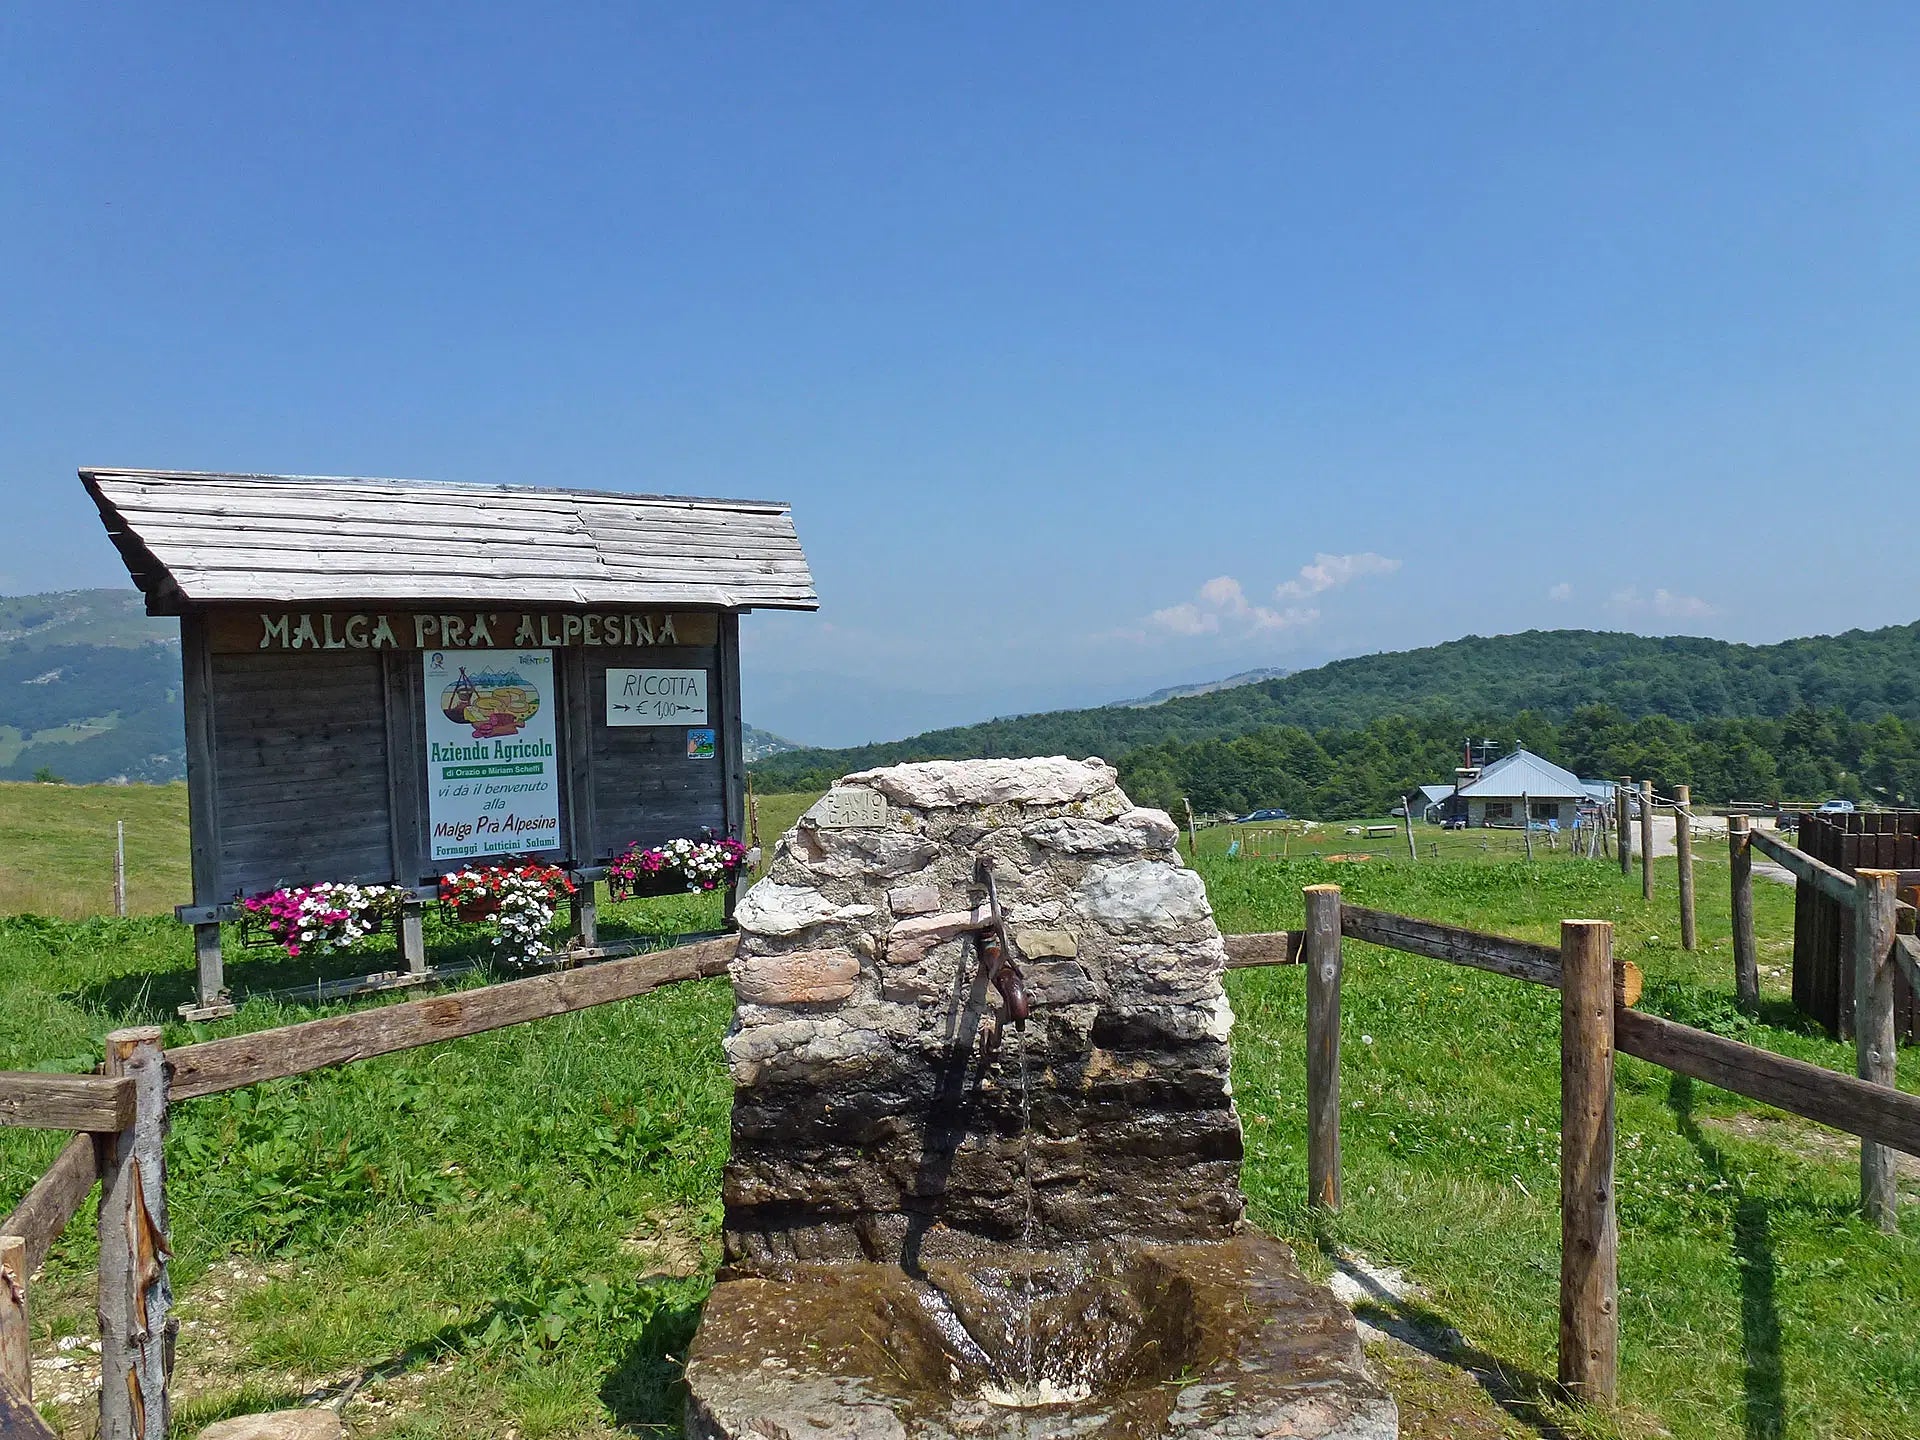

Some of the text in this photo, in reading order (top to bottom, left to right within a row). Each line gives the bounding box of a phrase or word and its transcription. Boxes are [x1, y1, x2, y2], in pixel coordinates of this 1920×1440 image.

[260, 614, 398, 649] MALGA
[515, 614, 679, 648] ALPESINA
[623, 674, 697, 696] RICOTTA
[431, 738, 553, 762] Azienda Agricola
[446, 769, 454, 777] di
[456, 768, 480, 776] Orazio
[488, 767, 513, 775] Miriam
[438, 785, 450, 797] vi
[473, 783, 483, 795] il
[484, 780, 549, 795] benvenuto
[482, 798, 506, 811] alla
[433, 821, 472, 842] Malga
[502, 813, 557, 836] Alpesina
[436, 836, 555, 856] Formaggi Latticini Salami
